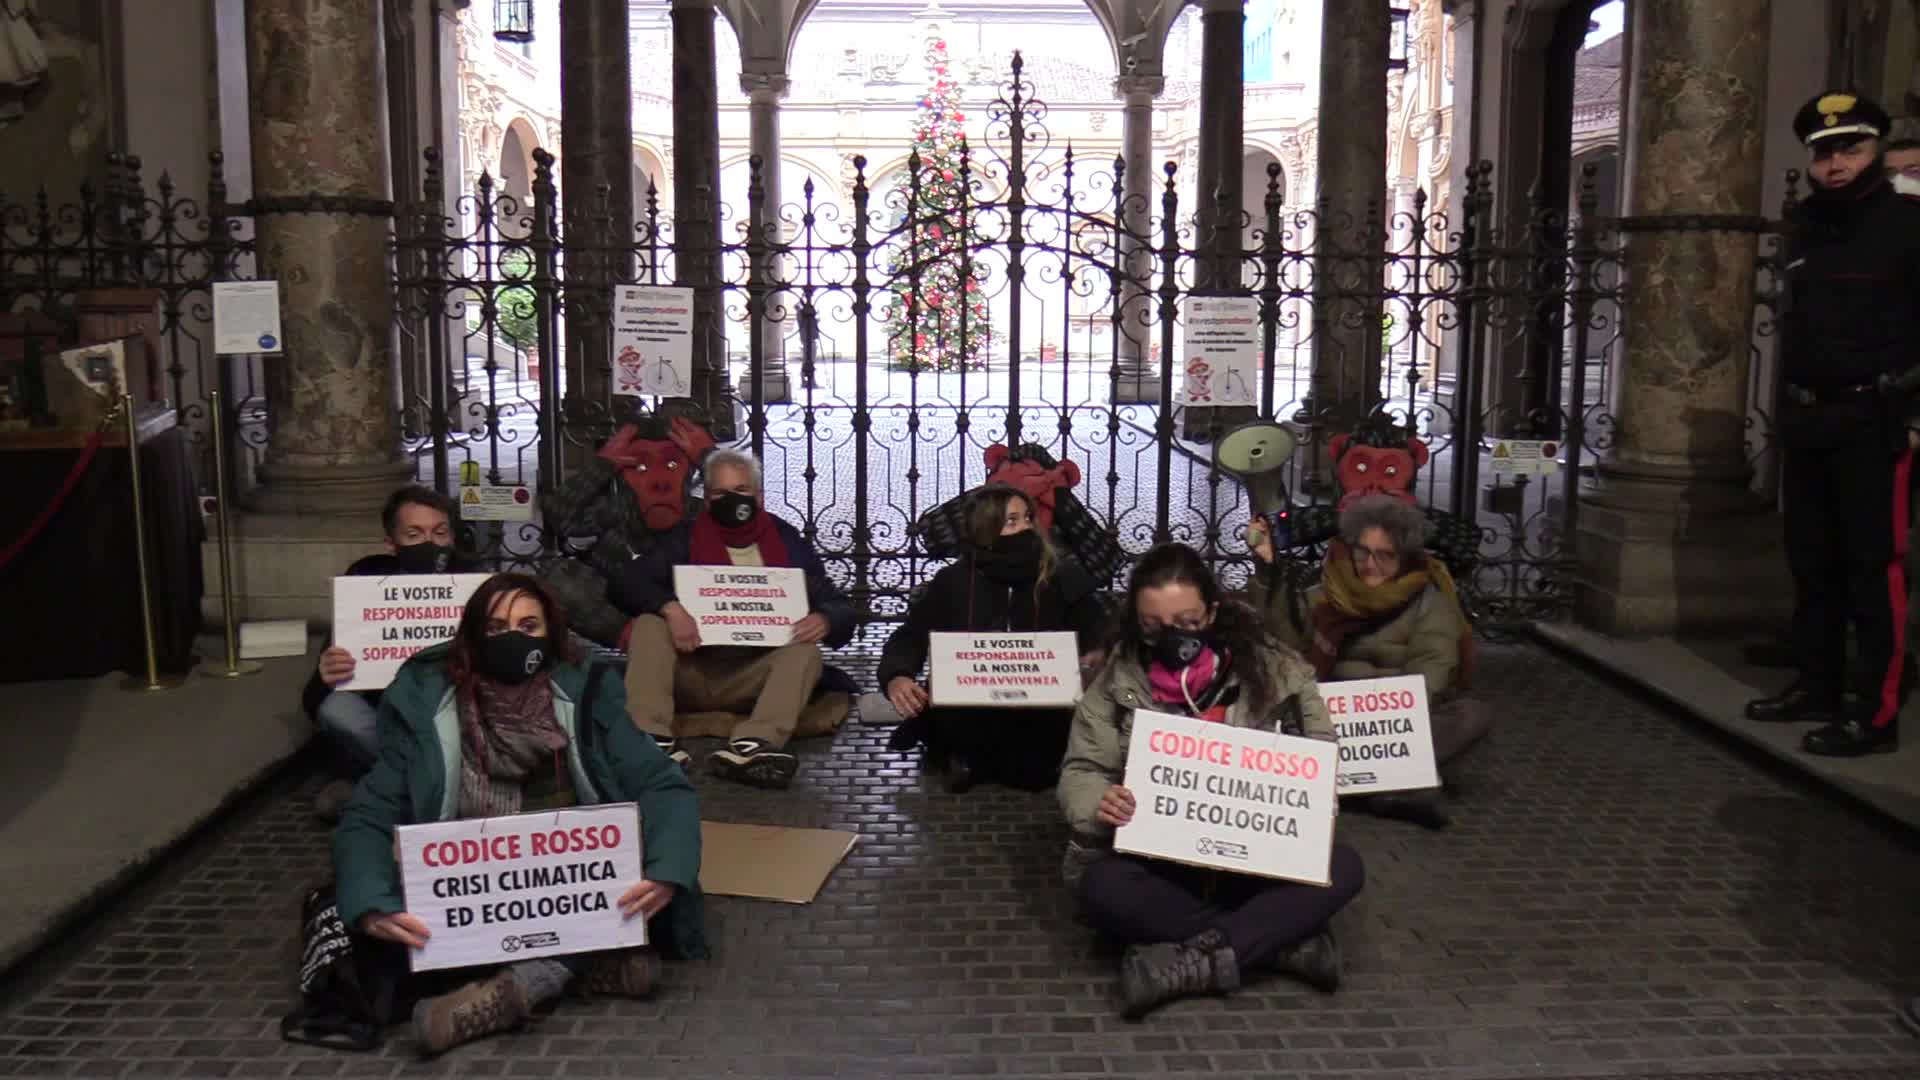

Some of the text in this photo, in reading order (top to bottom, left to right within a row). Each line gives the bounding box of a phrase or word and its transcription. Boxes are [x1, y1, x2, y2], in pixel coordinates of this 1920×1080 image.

[714, 574, 769, 585] LE VOSTRE
[384, 586, 454, 601] LE VOSTRE
[699, 586, 787, 598] RESPONSABILITÀ
[363, 605, 466, 621] RESPONSABILIT
[715, 602, 775, 612] LA NOSTRA
[701, 615, 791, 626] SOPRAVVIVENZA
[382, 625, 457, 640] LA NOSTRA
[974, 639, 1035, 648] LE VOSTRE
[956, 650, 1056, 660] RESPONSABILITÀ
[973, 663, 1040, 672] LA NOSTRA
[957, 676, 1060, 685] SOPRAVVIVENZA
[1352, 690, 1415, 713] ROSSO
[1149, 730, 1319, 780] CODICE ROSSO
[1340, 742, 1410, 762] OLOGICA
[1150, 765, 1310, 809] CRISI CLIMATICA
[1154, 795, 1299, 838] ED ECOLOGICA
[422, 824, 621, 867] CODICE ROSSO
[432, 860, 617, 898] CRISI CLIMATICA
[446, 892, 609, 928] ED ECOLOGICA
